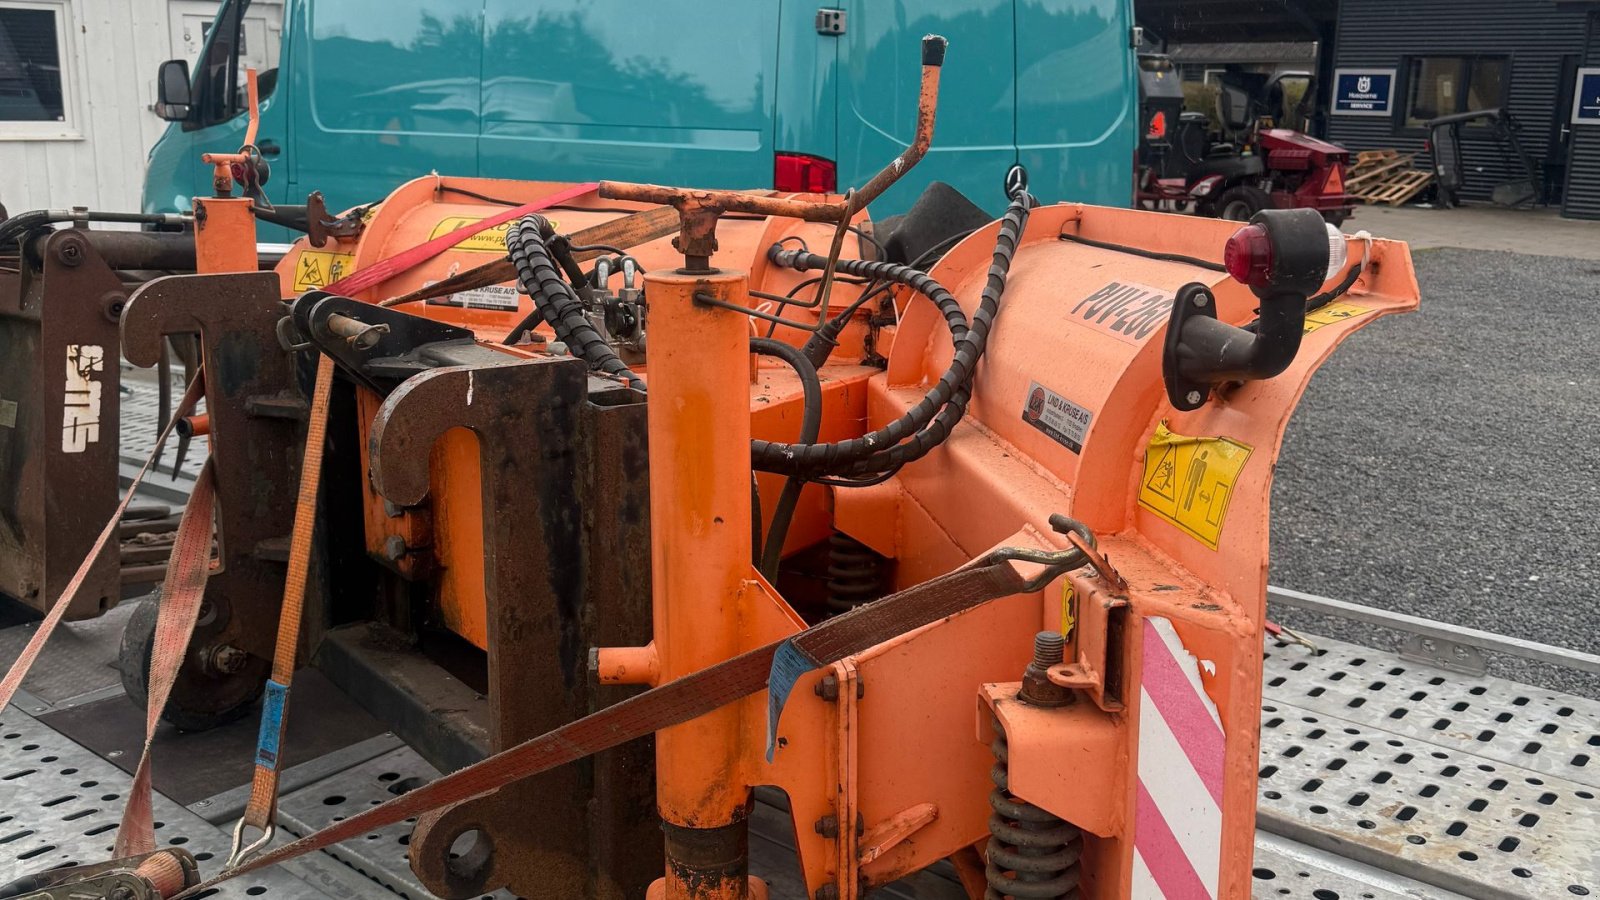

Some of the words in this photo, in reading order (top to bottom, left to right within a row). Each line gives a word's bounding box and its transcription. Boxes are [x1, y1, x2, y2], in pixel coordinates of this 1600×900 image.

[1047, 393, 1060, 408] LIND
[1062, 402, 1080, 421] KRUSE
[1077, 411, 1090, 425] A/S
